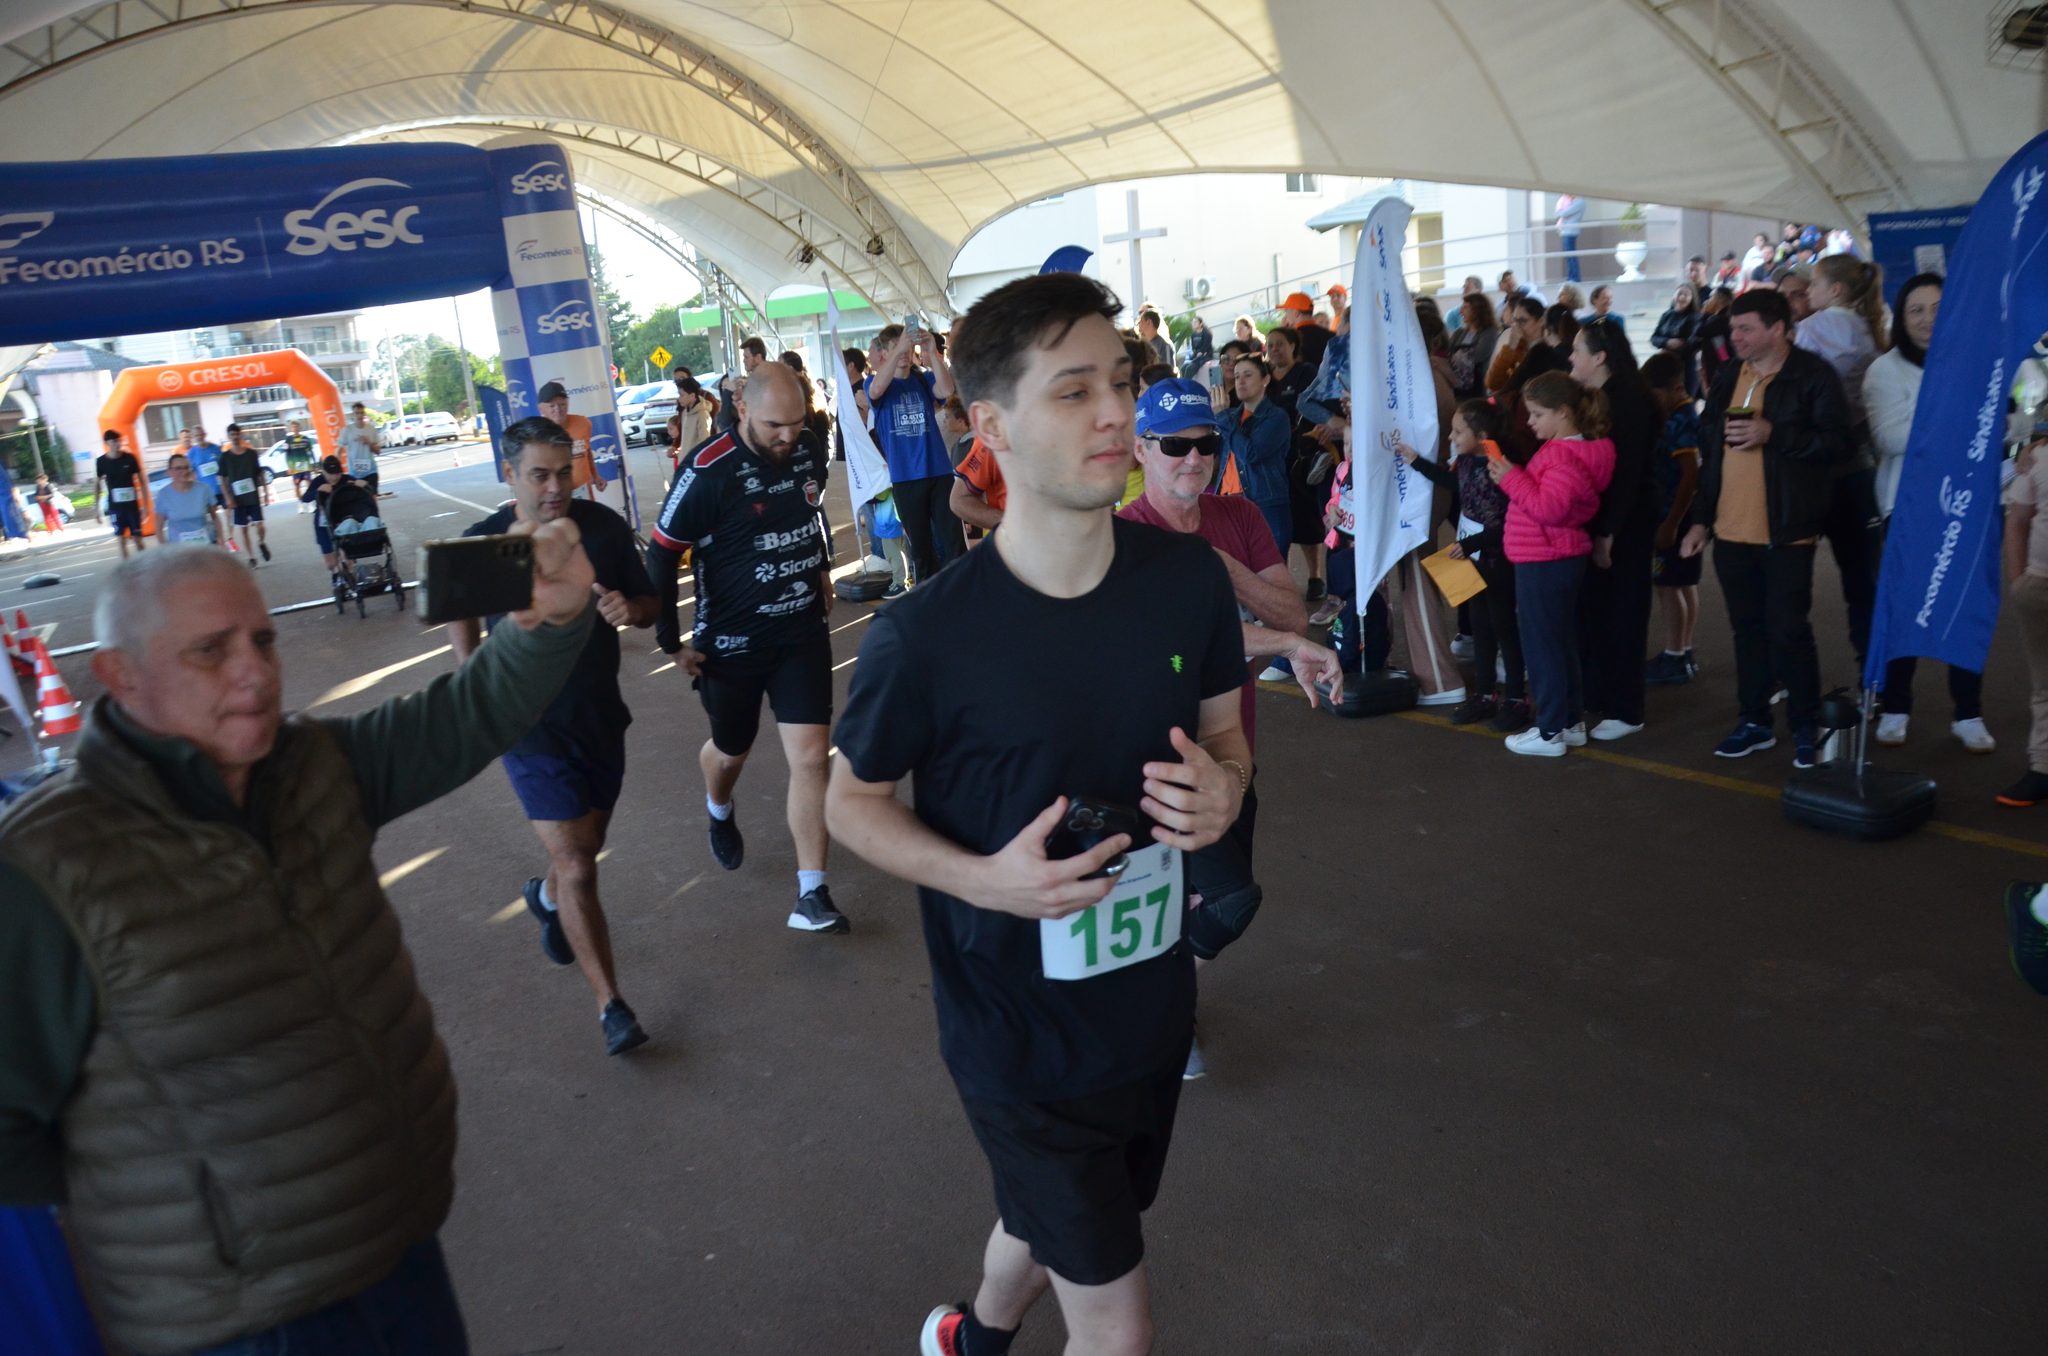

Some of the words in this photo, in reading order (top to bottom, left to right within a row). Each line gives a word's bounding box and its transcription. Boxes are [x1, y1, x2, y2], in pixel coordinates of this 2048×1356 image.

[511, 173, 567, 195] Sesc
[284, 205, 424, 256] Sesc
[0, 246, 193, 285] Fecomércio
[200, 238, 245, 267] RS
[520, 248, 572, 261] Fecomércio
[537, 311, 592, 335] Sesc
[188, 361, 273, 386] CRESOL
[1950, 488, 1973, 519] RS
[1070, 883, 1171, 967] 157
